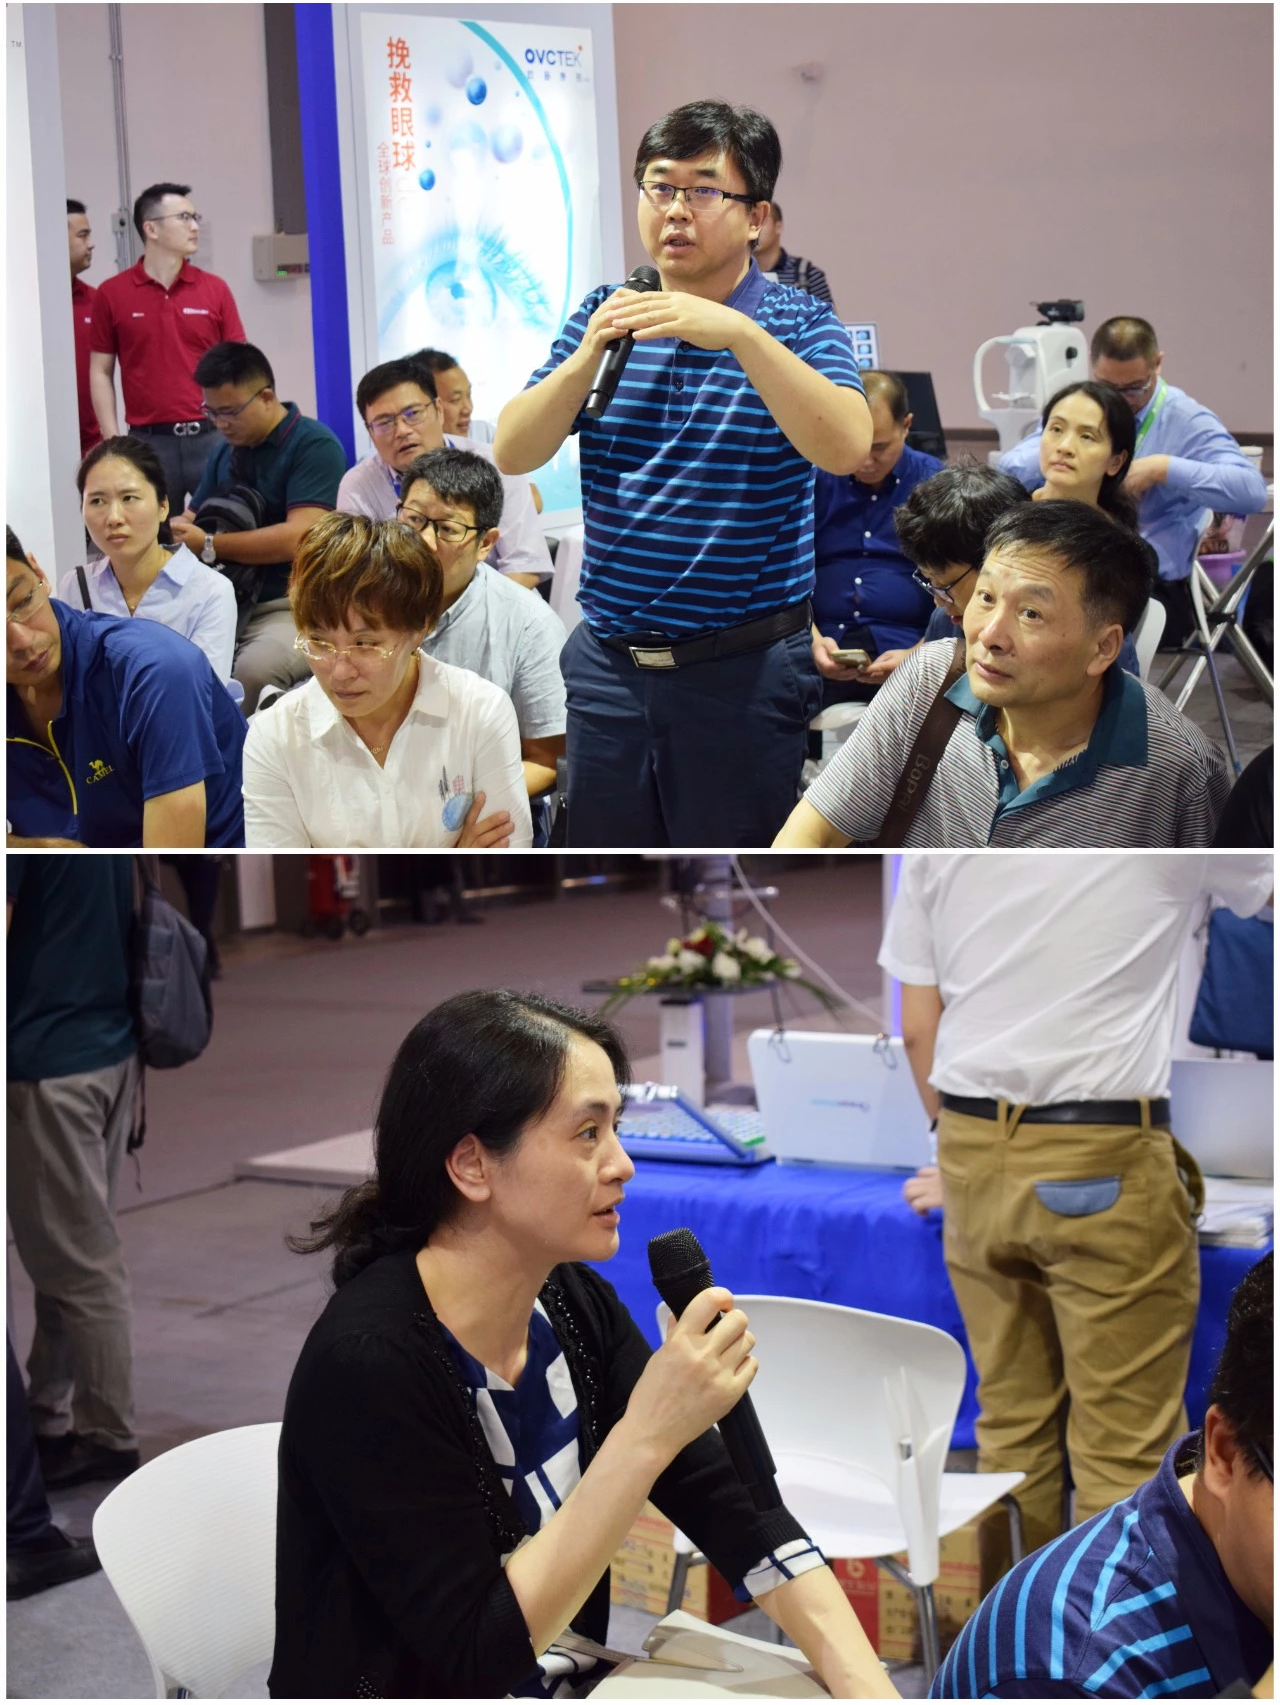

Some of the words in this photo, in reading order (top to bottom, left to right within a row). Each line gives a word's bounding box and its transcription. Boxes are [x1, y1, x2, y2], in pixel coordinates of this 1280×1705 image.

[525, 48, 583, 68] OVCTEK
[385, 36, 417, 172] 挽救眼球
[377, 142, 395, 246] 全球创新产品
[86, 765, 116, 784] CAMEL
